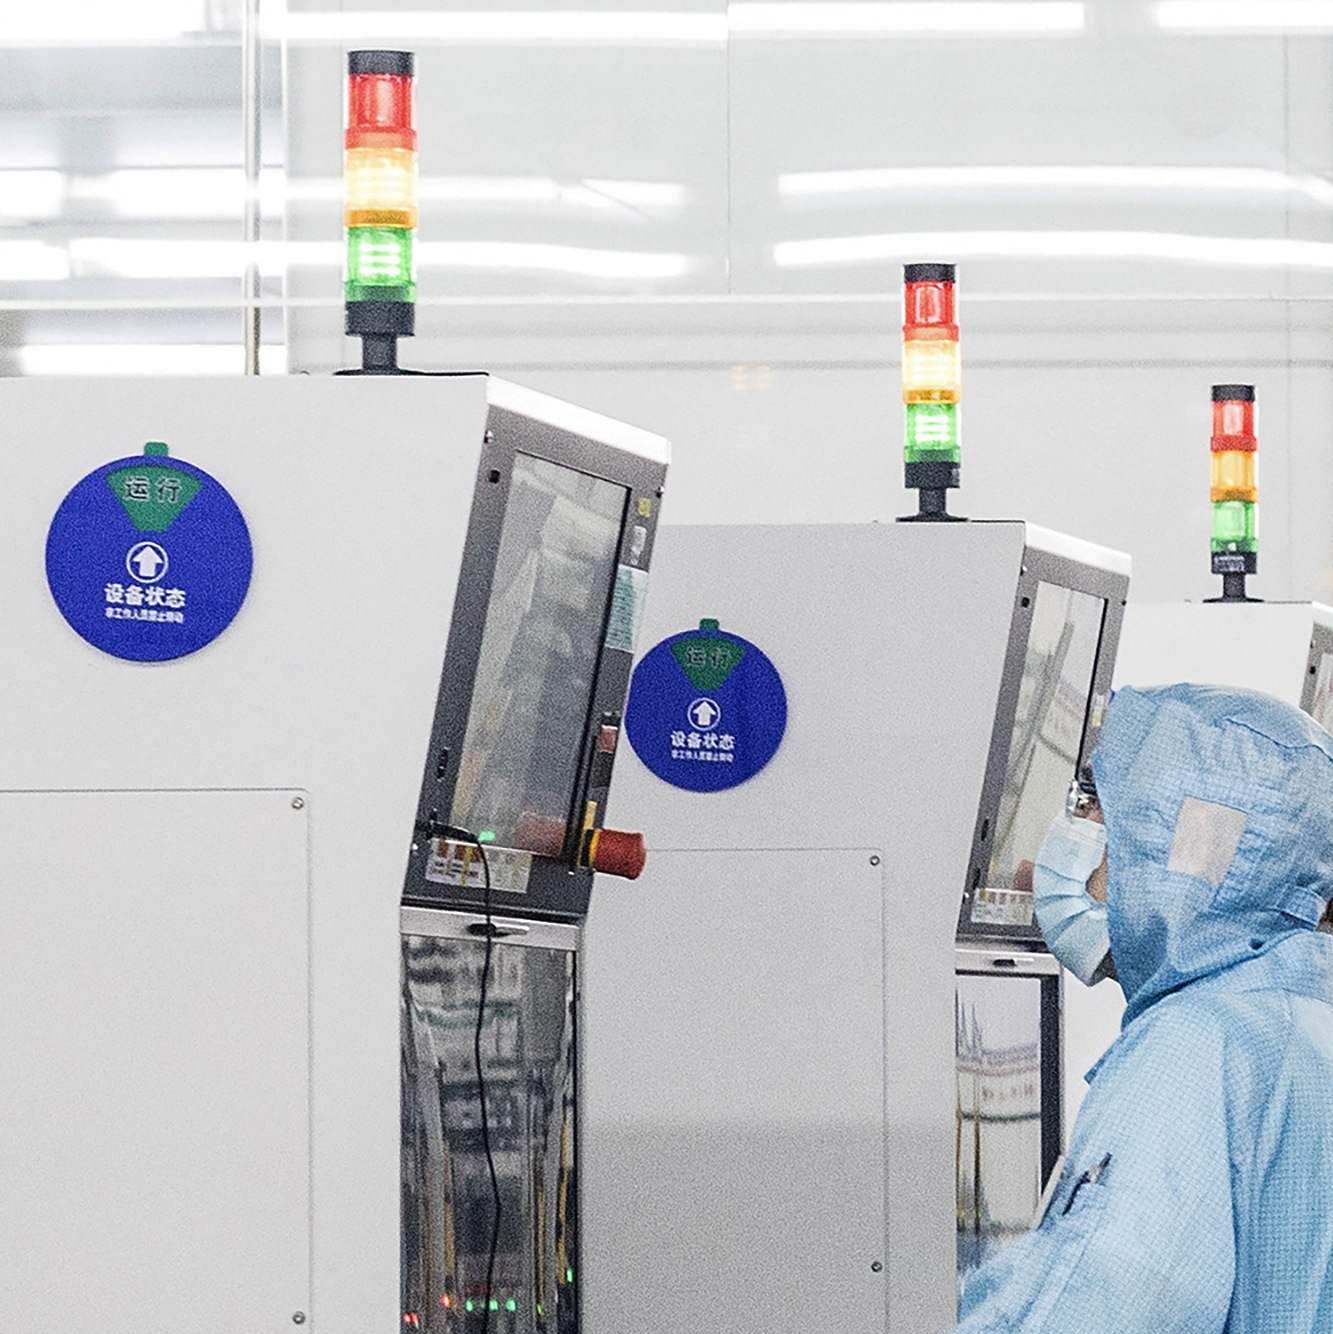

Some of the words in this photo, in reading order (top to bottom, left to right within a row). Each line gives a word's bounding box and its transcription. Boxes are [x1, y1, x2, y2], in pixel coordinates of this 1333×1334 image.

[125, 477, 183, 503] 运行
[104, 583, 186, 608] 设备状态
[670, 730, 736, 750] 设备状态
